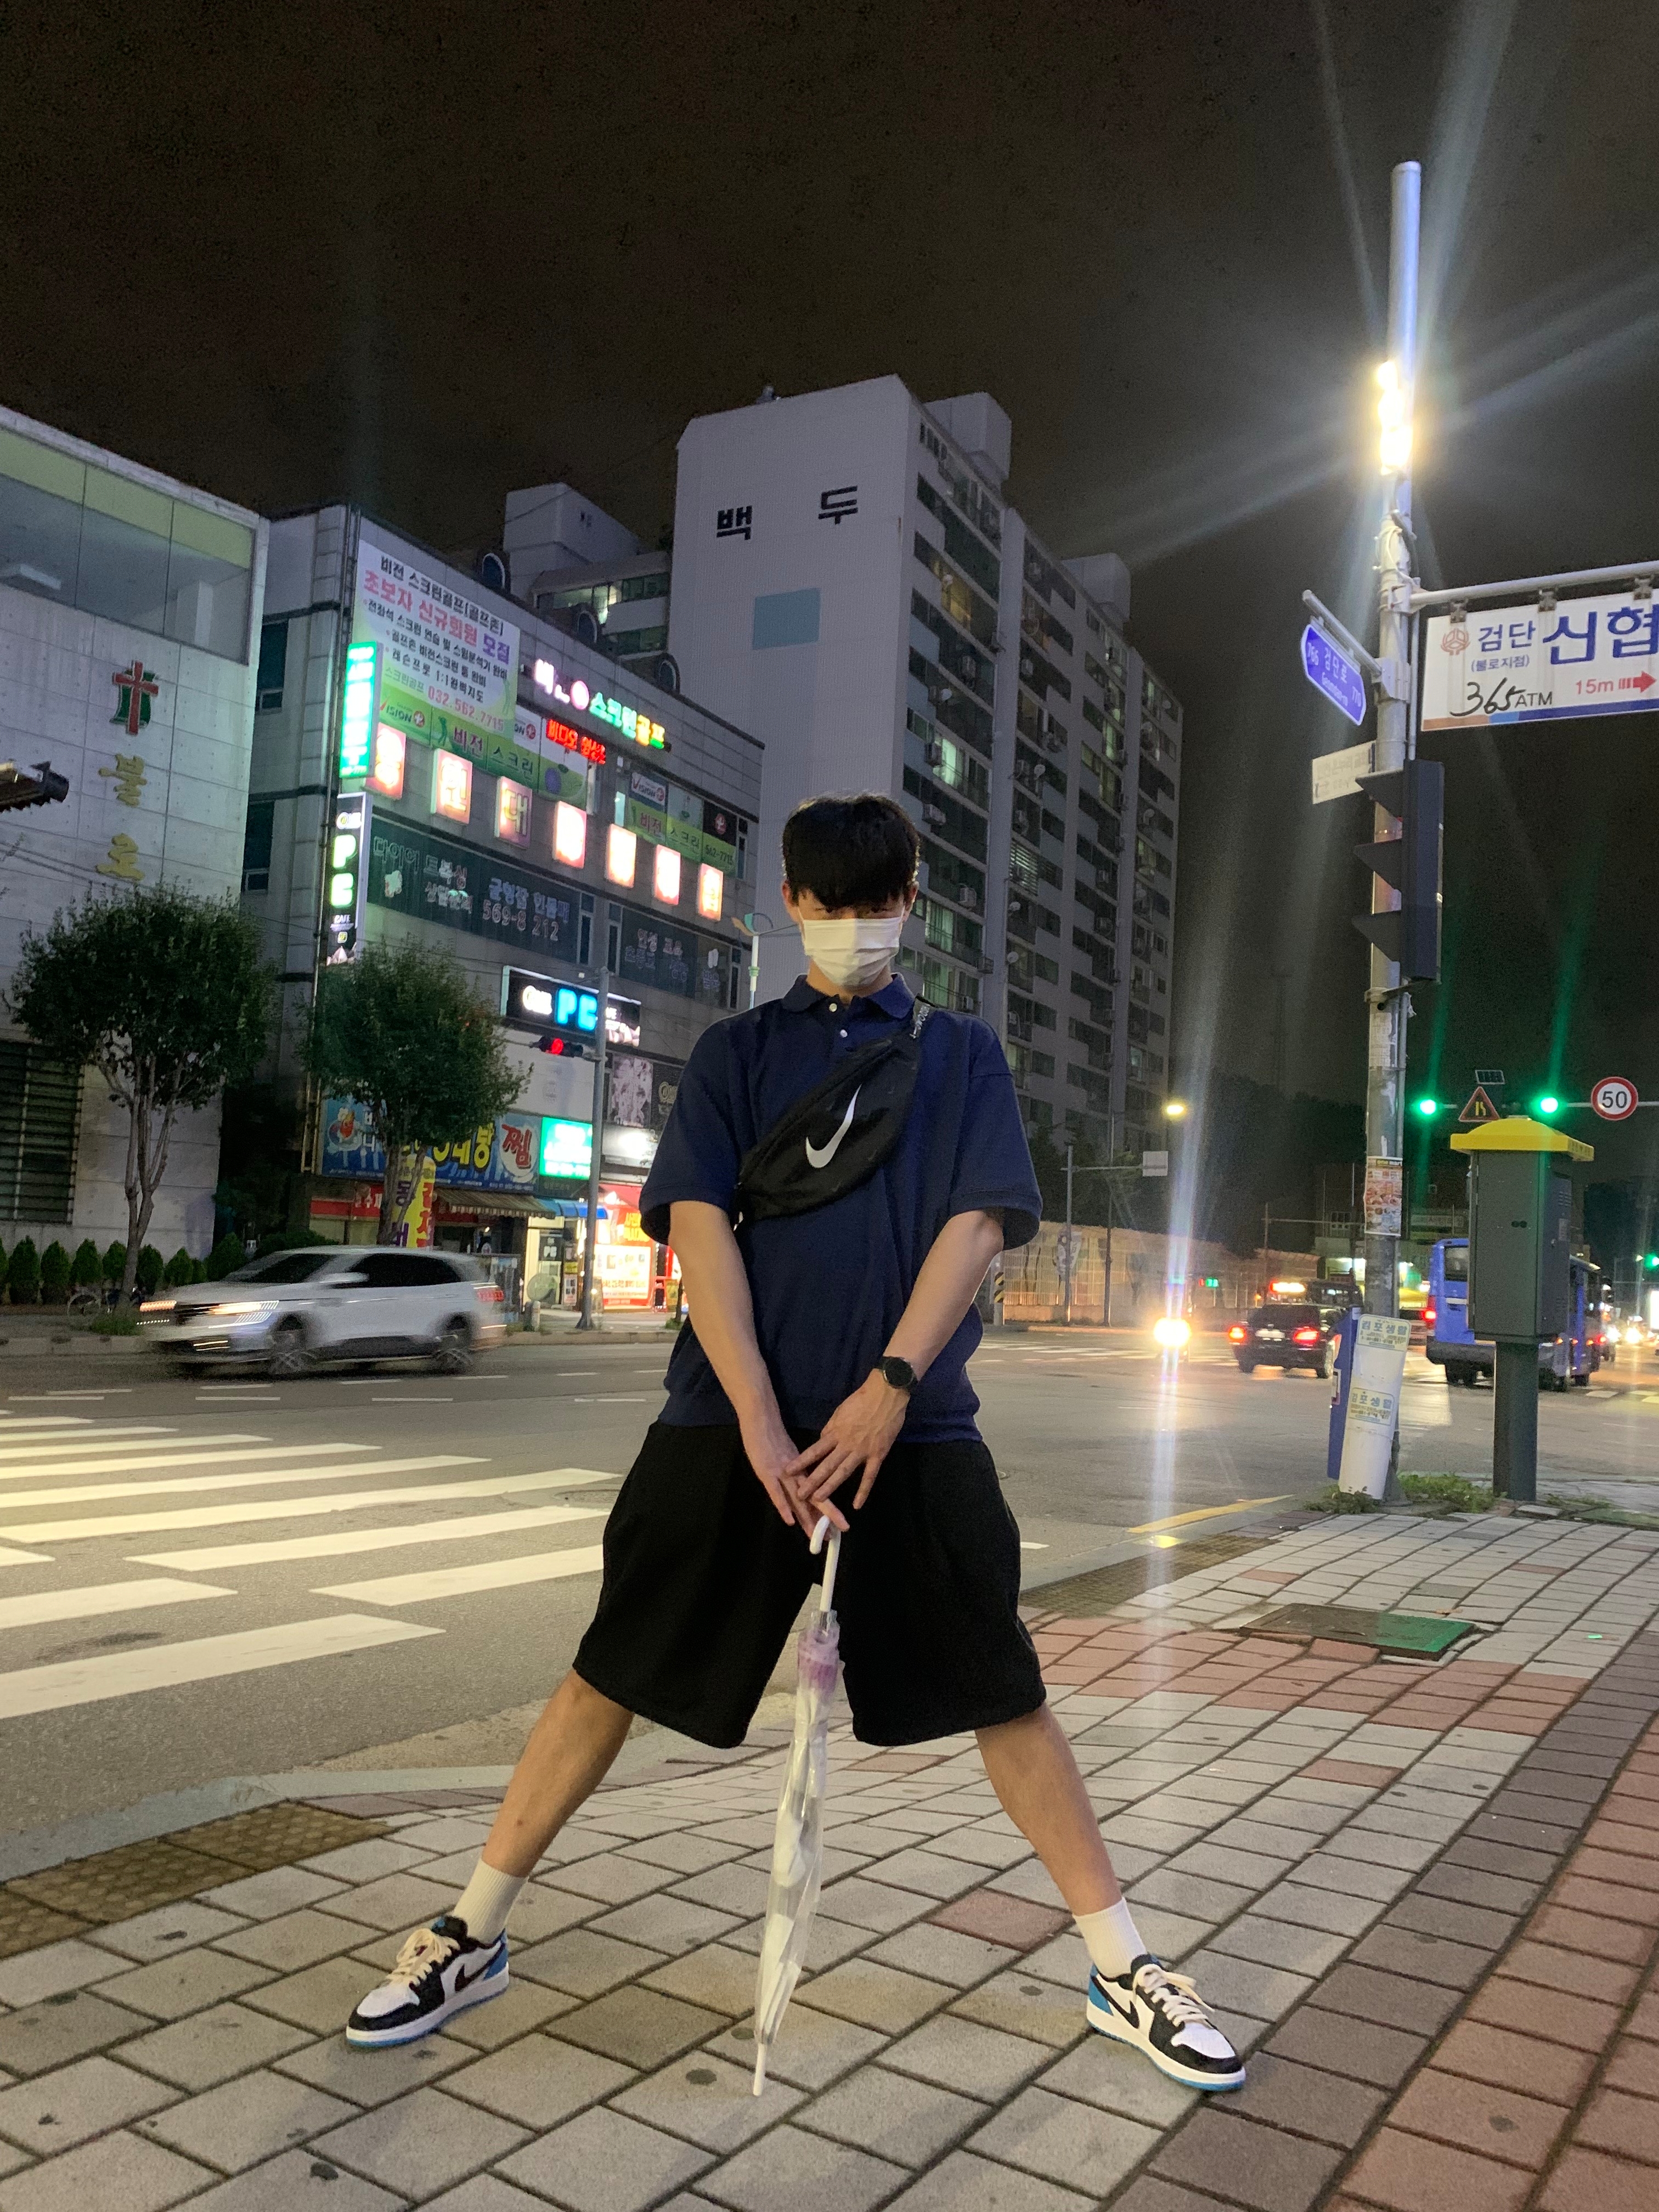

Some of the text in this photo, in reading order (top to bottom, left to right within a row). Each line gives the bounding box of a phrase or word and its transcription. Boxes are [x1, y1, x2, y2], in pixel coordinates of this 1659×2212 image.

[381, 555, 404, 581] 비전
[364, 569, 510, 665] 초보자 신규회원 모집
[396, 614, 422, 637] 스크린
[1478, 603, 1659, 665] 검단 신협
[1324, 646, 1348, 685] 검단로
[1471, 655, 1531, 673] (불로지점)
[1576, 678, 1614, 695] 15m
[546, 719, 578, 751] 비디오
[589, 691, 665, 750] 스크린골프
[453, 725, 534, 778] 비전 스크린
[640, 811, 663, 837] 비전
[1602, 1090, 1628, 1109] 50
[501, 1123, 533, 1169] 찜
